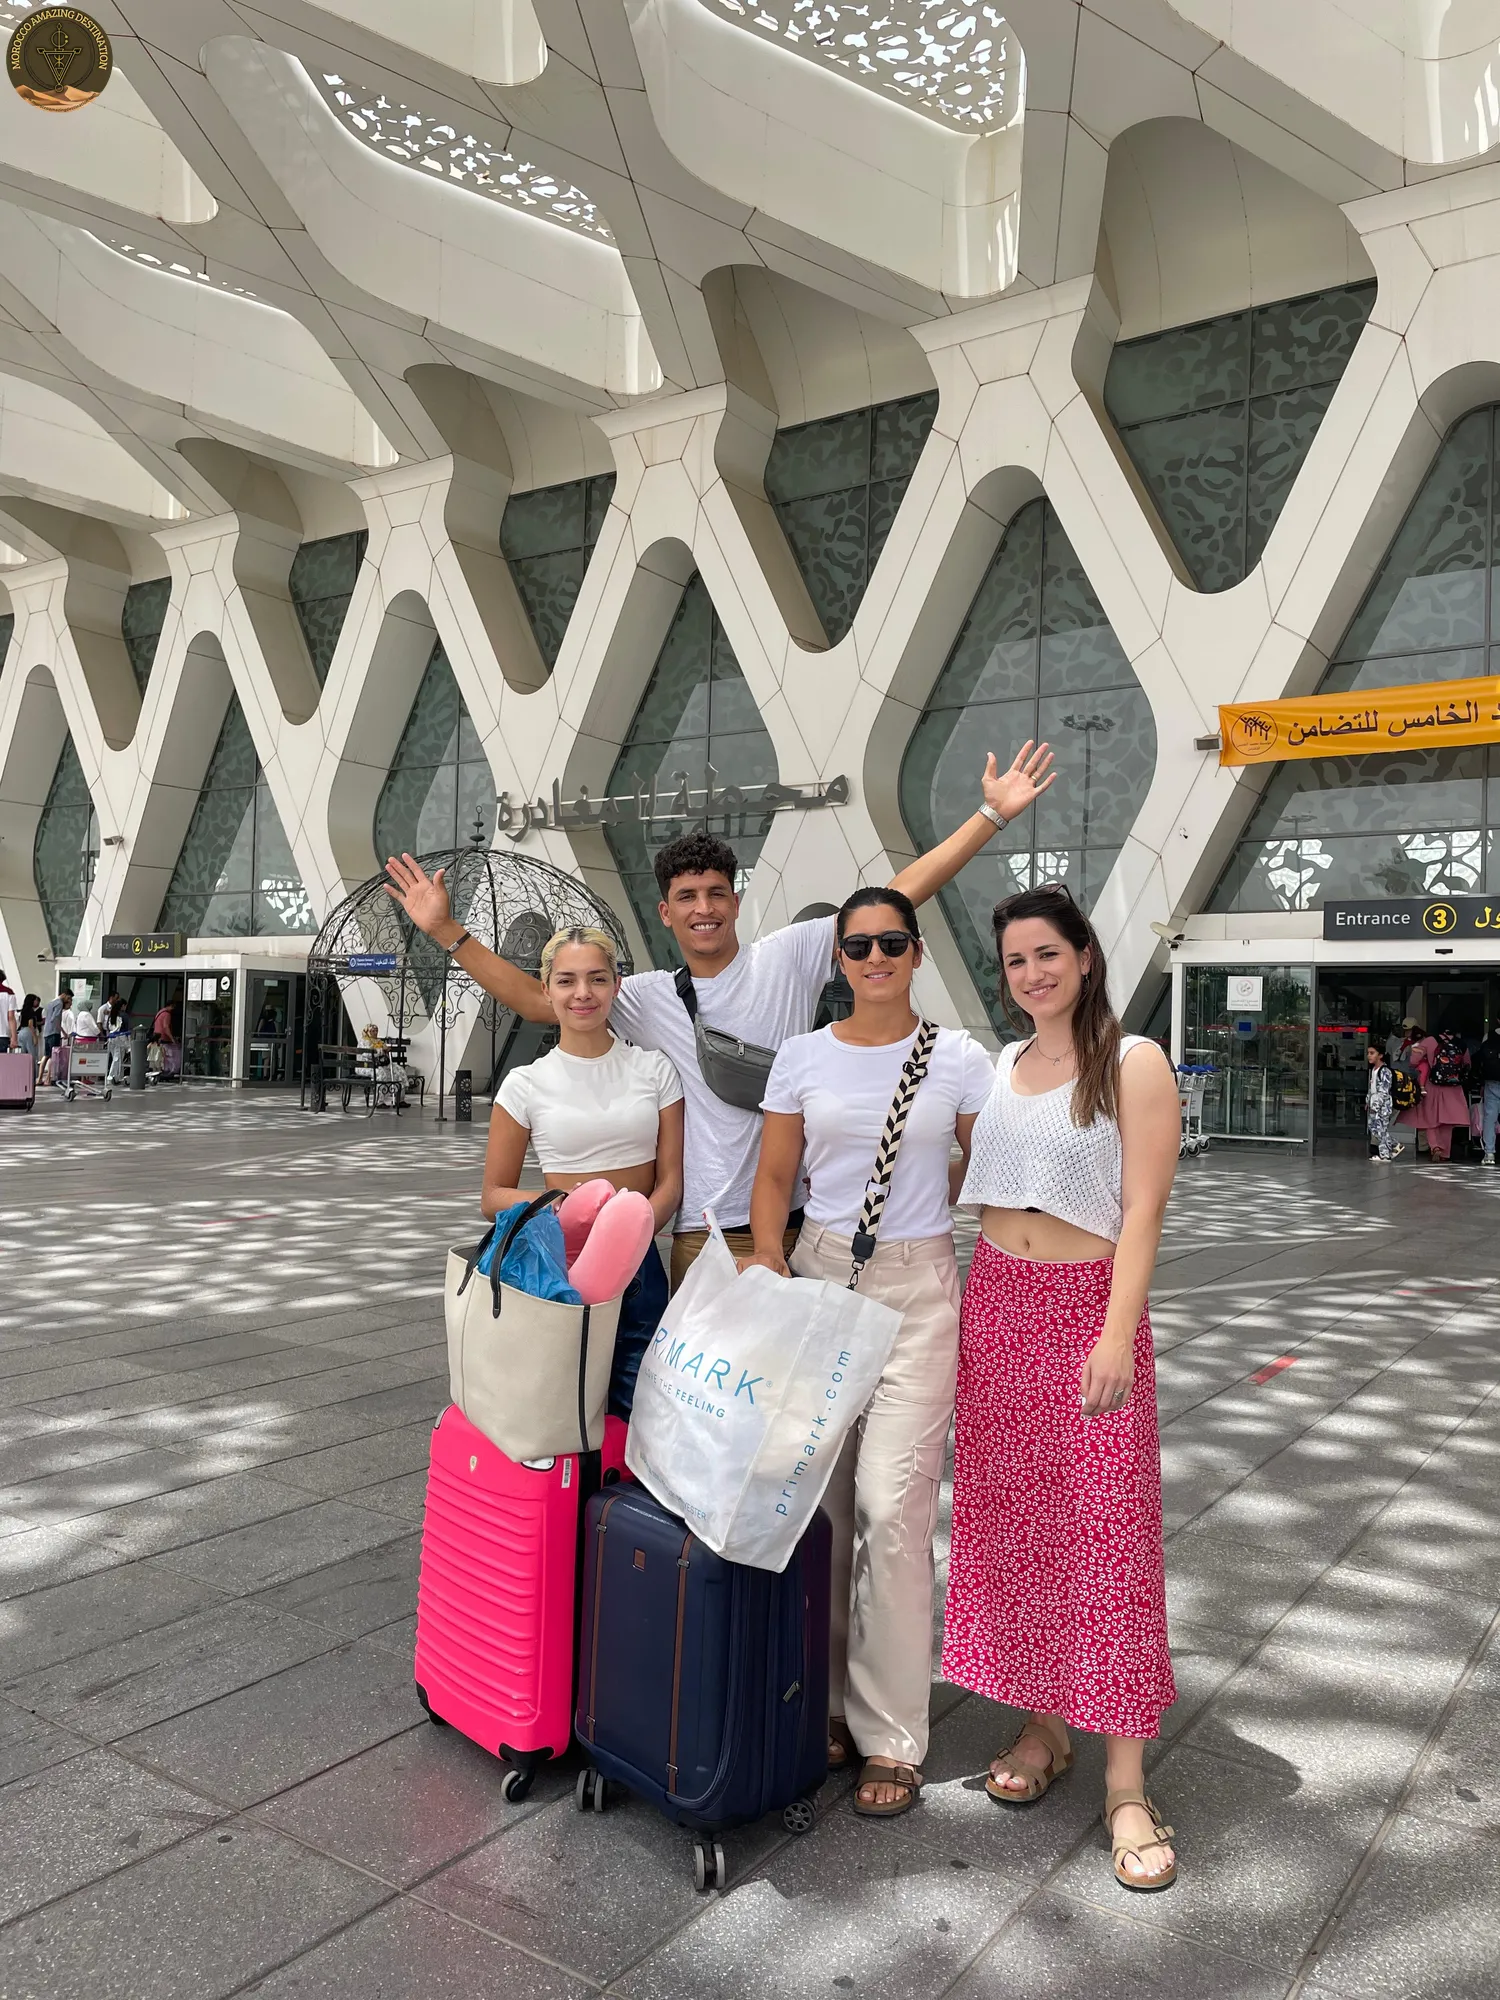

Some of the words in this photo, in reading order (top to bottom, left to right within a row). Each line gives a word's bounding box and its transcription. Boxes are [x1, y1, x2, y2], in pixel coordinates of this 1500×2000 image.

[1288, 709, 1379, 746] للتضامن
[1388, 700, 1478, 737] الخامس
[1336, 912, 1411, 926] Entrance
[1432, 909, 1447, 929] 3
[105, 941, 129, 950] Entrance
[147, 939, 170, 952] دخول
[660, 1378, 673, 1395] THE
[675, 1388, 726, 1418] FEELING
[775, 1350, 852, 1516] primark.com
